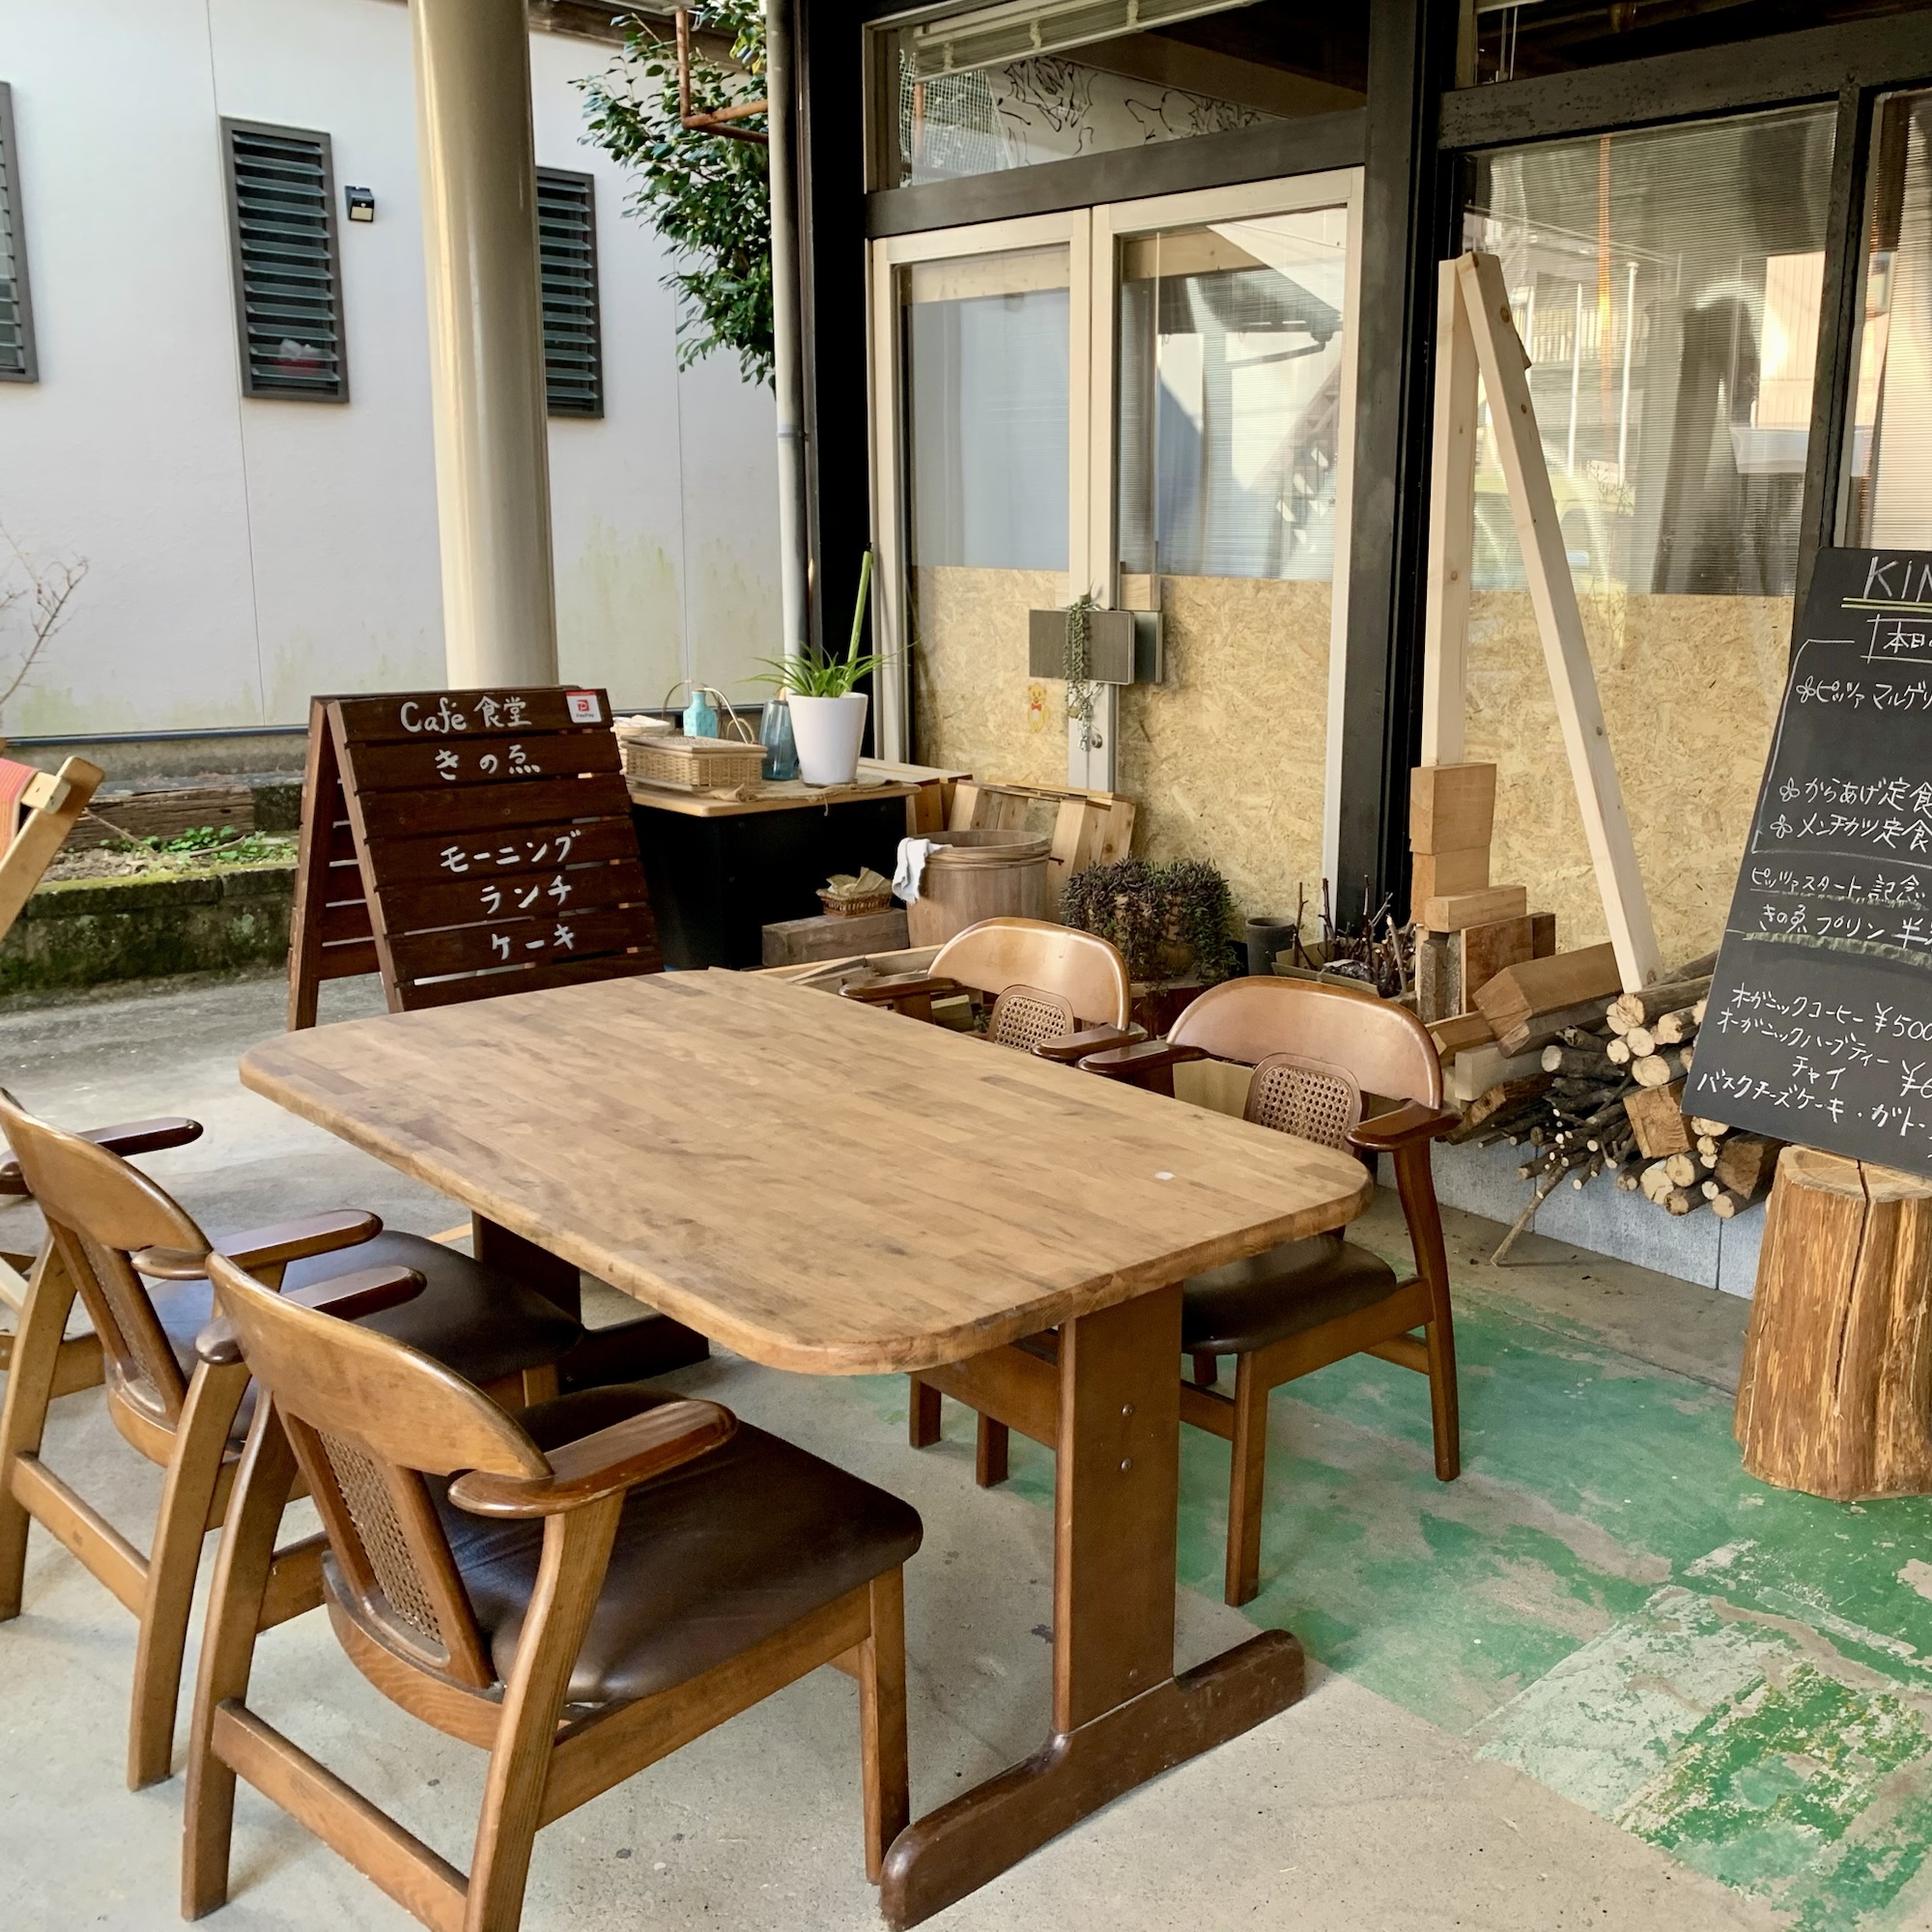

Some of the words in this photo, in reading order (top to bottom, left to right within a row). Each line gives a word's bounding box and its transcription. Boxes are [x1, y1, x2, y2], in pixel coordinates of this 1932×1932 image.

[1883, 621, 1932, 654] 本日
[400, 696, 467, 733] Café
[473, 696, 532, 727] 食堂
[1804, 777, 1932, 818] からあげ定食
[440, 829, 582, 873] モーニング
[1796, 812, 1932, 853] メンチカツ定食
[479, 875, 572, 914] ランチ
[492, 923, 575, 960] ケーキ
[1817, 916, 1885, 939] プリン
[1890, 918, 1932, 949] 半
[1792, 1056, 1846, 1090] チャイ
